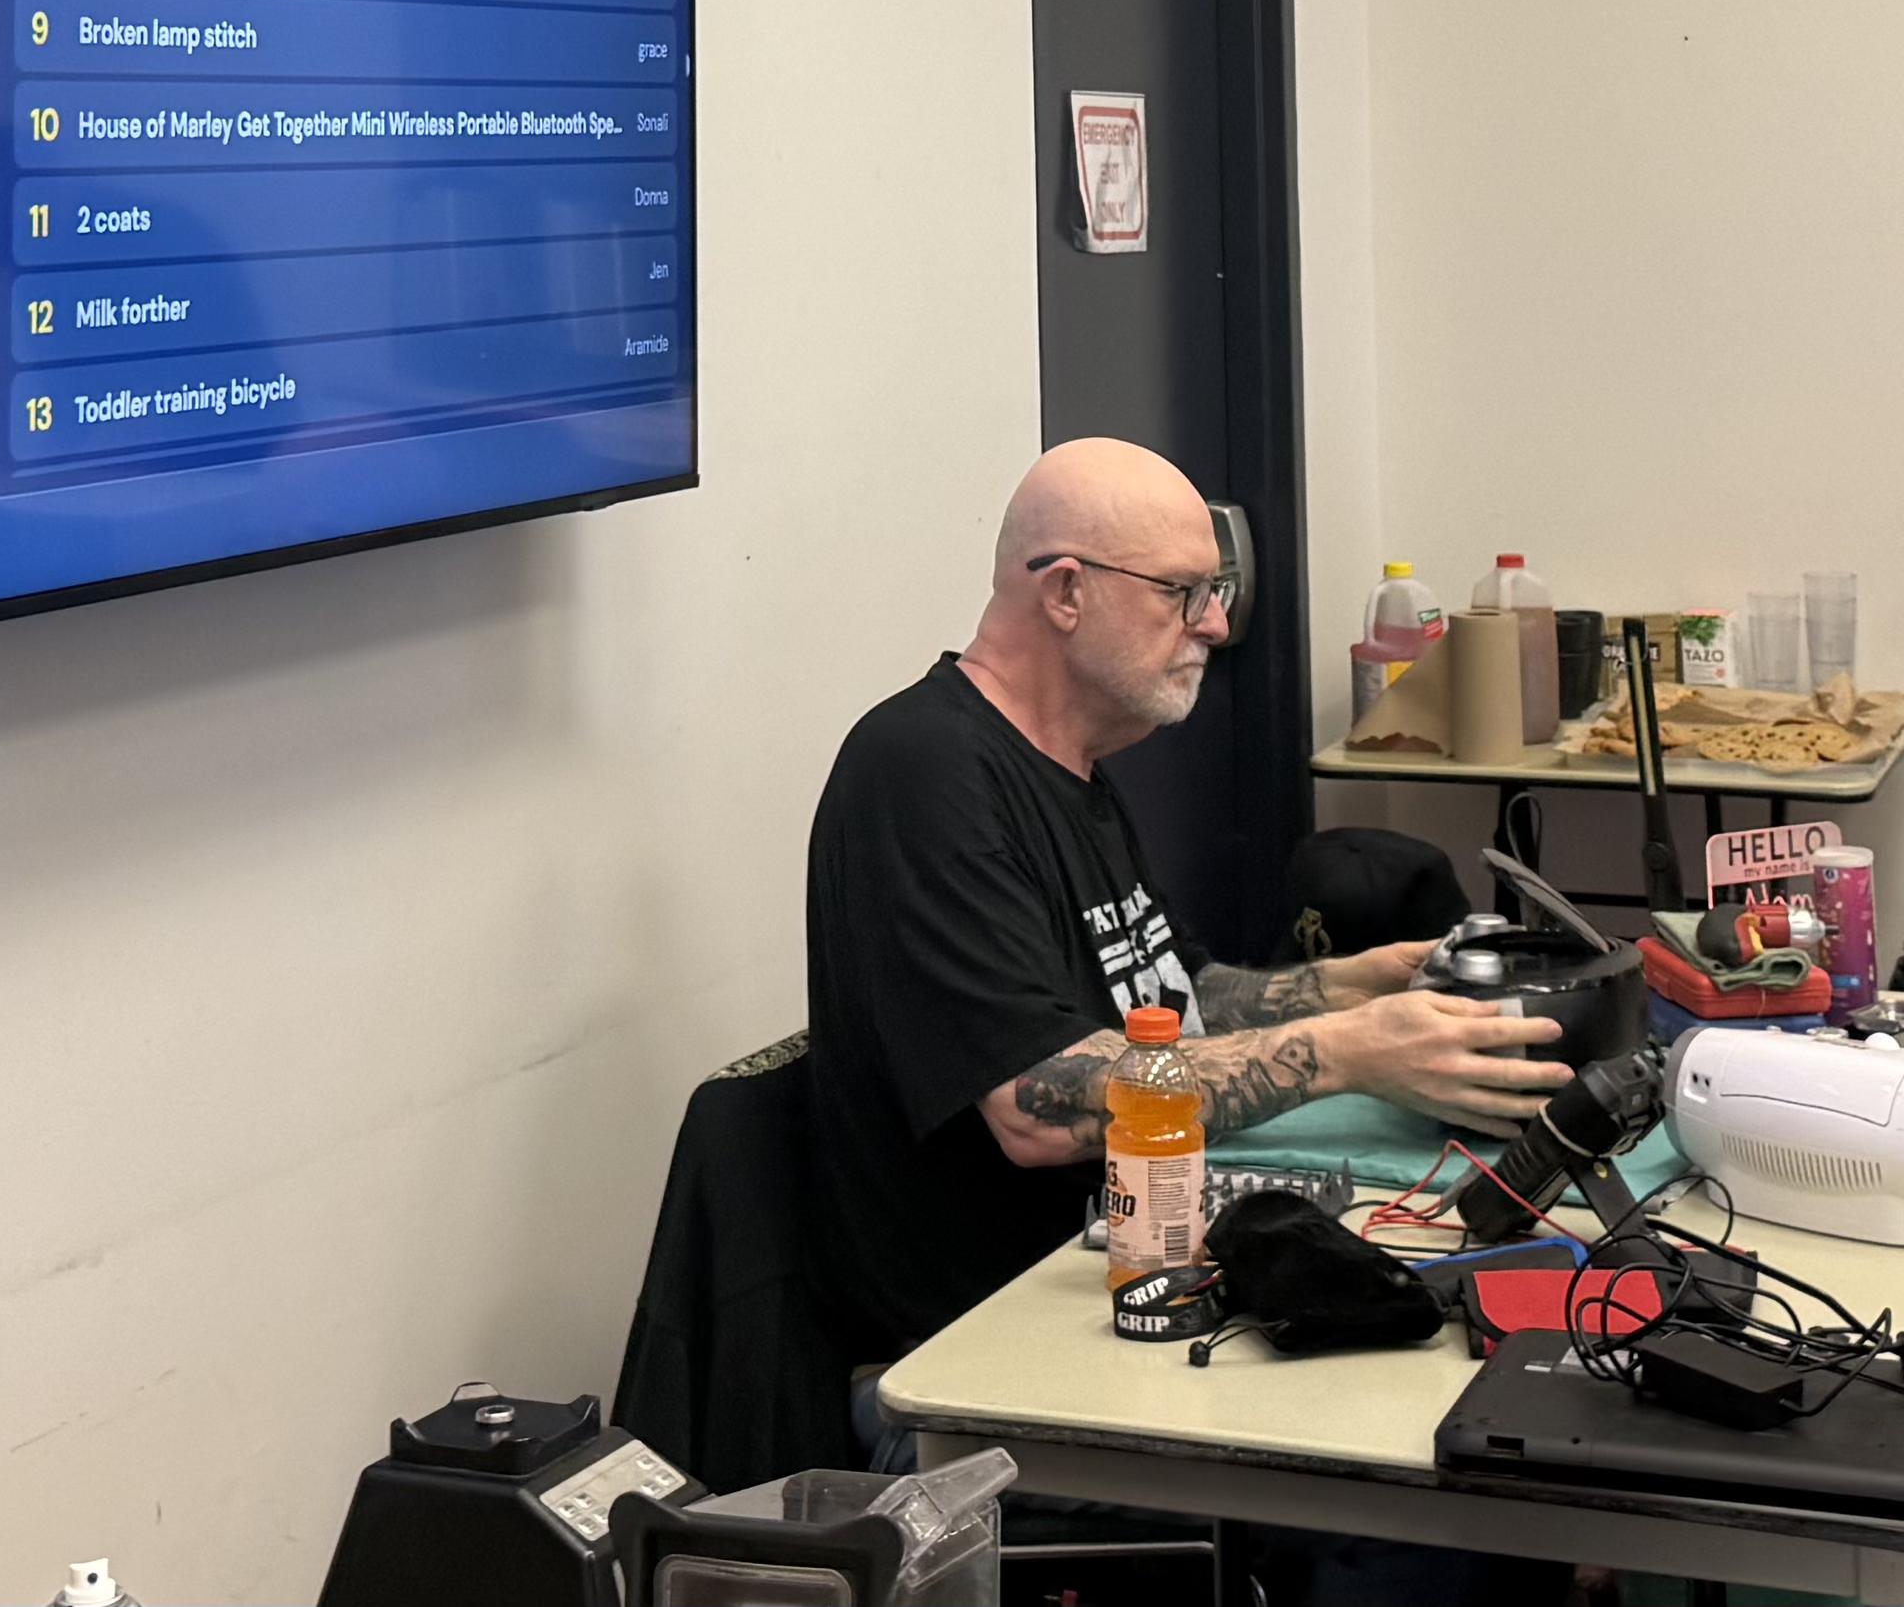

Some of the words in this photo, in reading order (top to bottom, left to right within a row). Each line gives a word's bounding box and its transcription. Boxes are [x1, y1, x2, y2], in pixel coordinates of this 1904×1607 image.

[31, 10, 49, 45] 9
[78, 16, 149, 46] Broken
[152, 18, 201, 55] lamp
[203, 20, 258, 49] stitch
[637, 43, 668, 63] grace
[29, 107, 60, 142] 10
[78, 111, 142, 140] House
[145, 110, 166, 139] of
[170, 110, 234, 146] Marley
[236, 110, 271, 138] Get
[273, 110, 349, 145] Together
[350, 110, 386, 136] Mini
[387, 110, 455, 136] Wireless
[456, 110, 519, 136] Portable
[520, 110, 587, 135] Bluetooth
[636, 112, 669, 132] Sonali
[633, 186, 669, 207] Donna
[28, 204, 49, 238] 11
[76, 205, 91, 234] 2
[93, 206, 151, 234] coats
[648, 261, 669, 280] Jen
[27, 299, 54, 334] 12
[75, 297, 118, 329] Milk
[120, 294, 191, 325] forther
[623, 333, 669, 357] Aramide
[25, 395, 52, 432] 13
[73, 389, 152, 424] Toddler
[153, 381, 228, 415] training
[230, 373, 296, 410] bicycle
[1684, 649, 1725, 663] TAZO
[1728, 826, 1826, 866] HELLO
[1744, 865, 1760, 877] my
[1764, 863, 1797, 876] name
[1106, 1186, 1137, 1217] ERO
[1123, 1276, 1170, 1307] GRIP
[1117, 1311, 1171, 1333] GRIP
